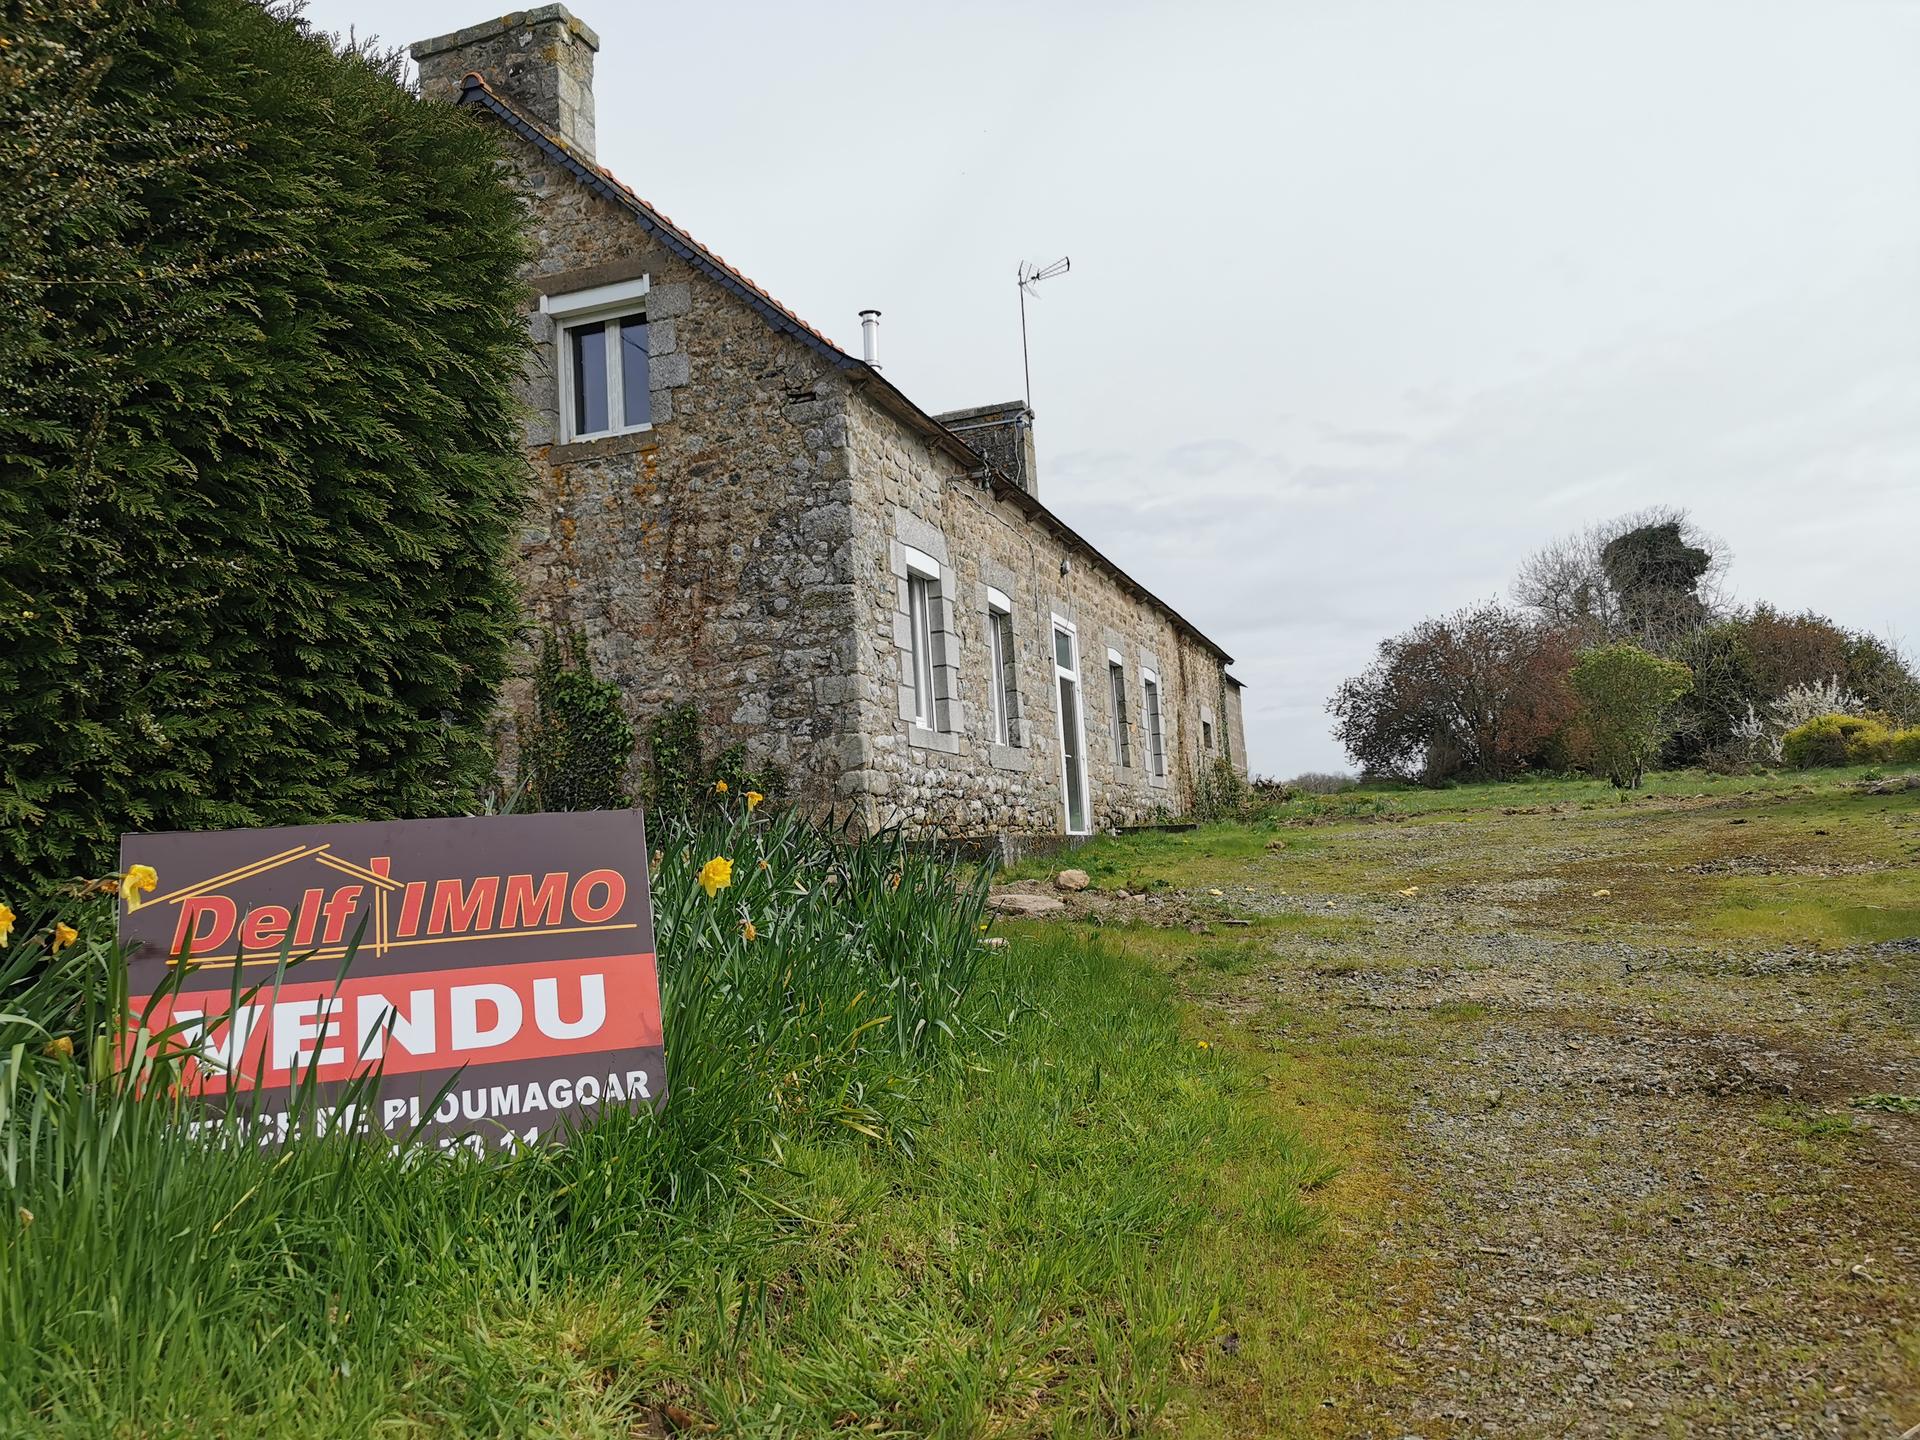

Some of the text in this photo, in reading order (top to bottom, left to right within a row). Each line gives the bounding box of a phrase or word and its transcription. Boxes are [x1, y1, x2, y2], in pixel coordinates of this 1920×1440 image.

[170, 868, 627, 956] Delf IMMO
[172, 973, 607, 1077] VENDU
[383, 1069, 651, 1131] PLOUMAGOAR
[499, 1126, 539, 1157] 11
